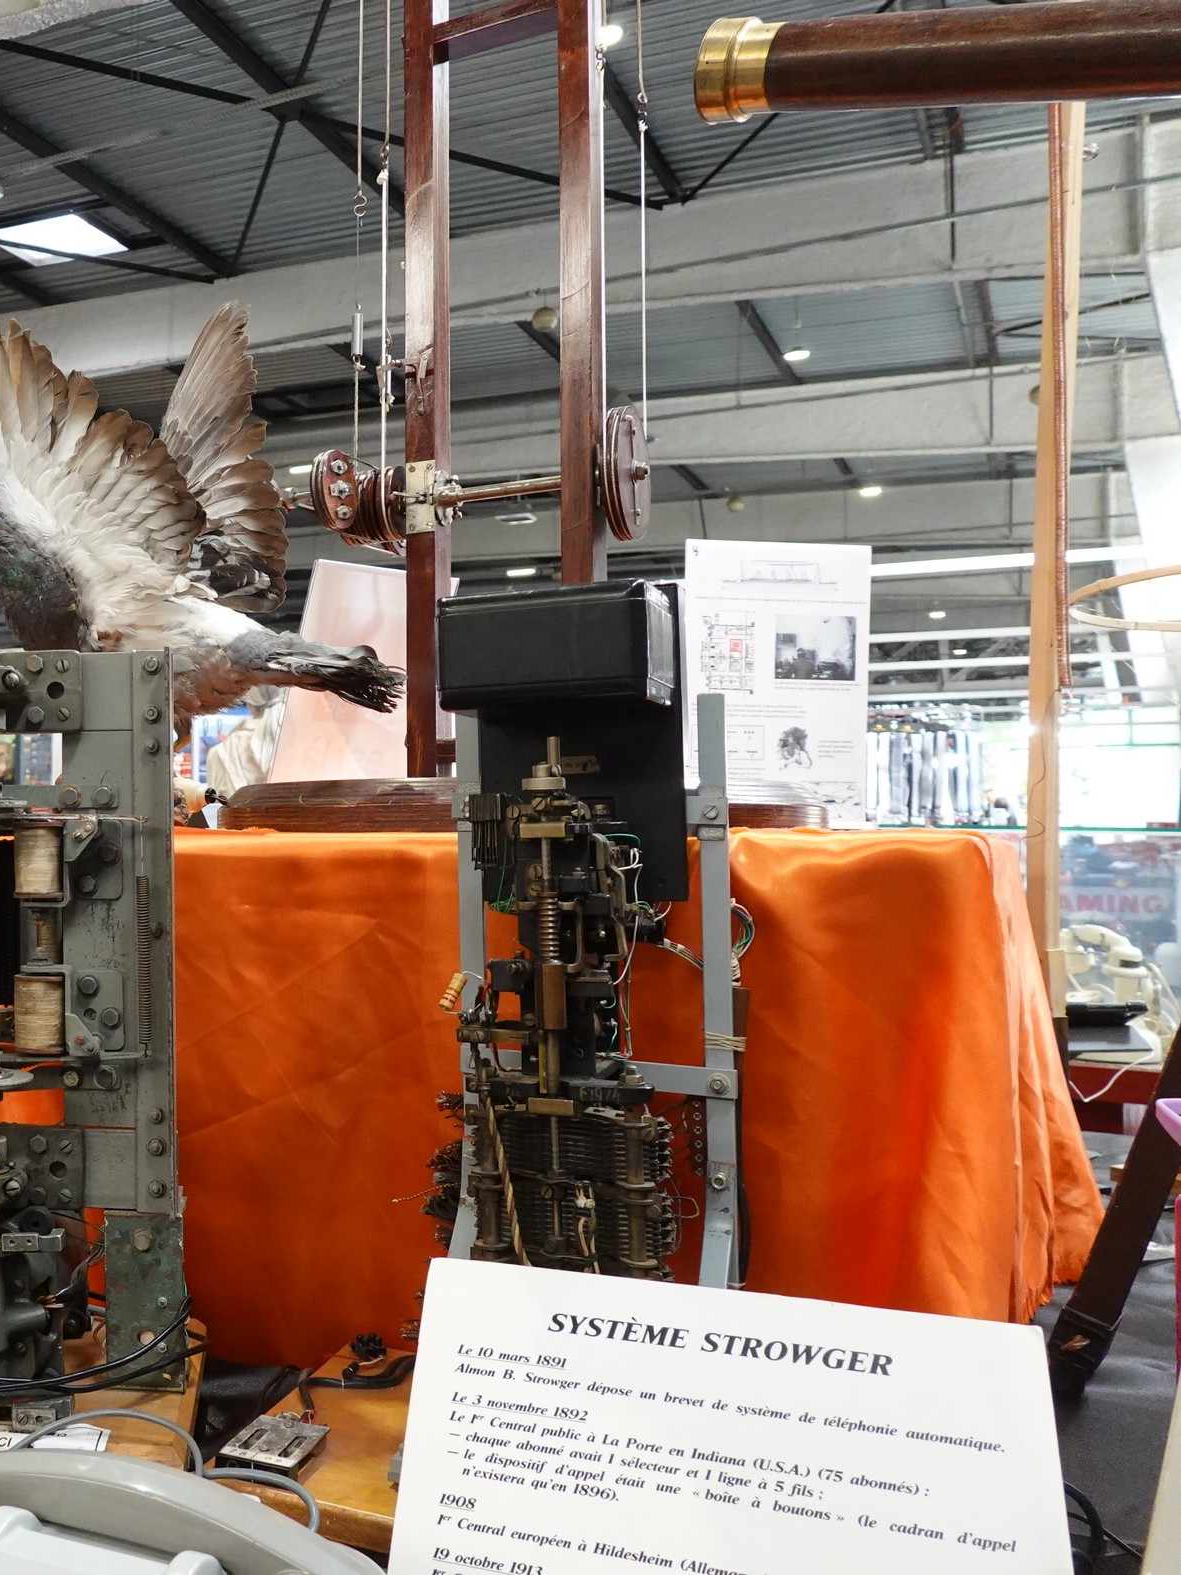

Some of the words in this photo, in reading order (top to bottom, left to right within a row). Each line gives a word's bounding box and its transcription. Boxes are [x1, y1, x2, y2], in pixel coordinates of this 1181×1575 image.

[457, 1344, 473, 1355] Le
[477, 1347, 494, 1358] 10
[499, 1352, 530, 1363] mars
[536, 1354, 567, 1368] 1891
[547, 1312, 689, 1349] SYSTÈME
[700, 1332, 893, 1376] STROWGER
[451, 1391, 467, 1403] Le
[471, 1394, 483, 1405] 3
[487, 1398, 548, 1417] novembre
[553, 1406, 589, 1422] 1892
[455, 1362, 496, 1378] Almon
[502, 1368, 516, 1380] B.
[523, 1371, 581, 1390] Strowger
[587, 1380, 633, 1397] dépose
[639, 1390, 656, 1400] un
[664, 1391, 704, 1408] brevet
[711, 1399, 729, 1411] de
[735, 1403, 791, 1420] système
[798, 1412, 816, 1424] de
[823, 1415, 898, 1437] téléphonie
[905, 1428, 1005, 1452] automatique.
[449, 1410, 465, 1422] Le
[489, 1416, 537, 1433] Central
[540, 1424, 581, 1442] public
[587, 1431, 596, 1443] à
[601, 1433, 620, 1447] La
[625, 1437, 663, 1453] Porte
[668, 1447, 685, 1457] en
[690, 1448, 746, 1467] Indiana
[753, 1457, 811, 1478] (U.S.A.)
[818, 1467, 844, 1483] (75
[849, 1475, 920, 1496] abonnés)
[465, 1432, 511, 1449] chaque
[516, 1440, 564, 1456] abonné
[569, 1448, 603, 1462] avait
[619, 1456, 681, 1476] sélecteur
[686, 1467, 699, 1479] et
[717, 1471, 752, 1488] ligne
[757, 1478, 768, 1490] à
[774, 1480, 785, 1493] 5
[787, 1483, 815, 1498] fils
[439, 1493, 477, 1510] 1908
[462, 1465, 526, 1486] n'existera
[531, 1478, 567, 1493] qu'en
[572, 1482, 620, 1502] 1896).
[463, 1449, 476, 1461] le
[484, 1452, 548, 1473] dispositif
[554, 1463, 605, 1482] d'appel
[615, 1473, 645, 1489] était
[655, 1483, 682, 1495] une
[705, 1488, 741, 1505] boîte
[751, 1496, 761, 1509] à
[772, 1499, 831, 1521] boutons
[857, 1513, 878, 1529] (le
[889, 1522, 944, 1540] cadran
[957, 1531, 1017, 1553] d'appel
[432, 1546, 450, 1560] 19
[454, 1552, 505, 1572] octobre
[509, 1561, 544, 1575] 1913
[457, 1517, 506, 1537] Central
[510, 1528, 572, 1550] européen
[577, 1538, 588, 1553] à
[593, 1541, 674, 1569] Hildesheim
